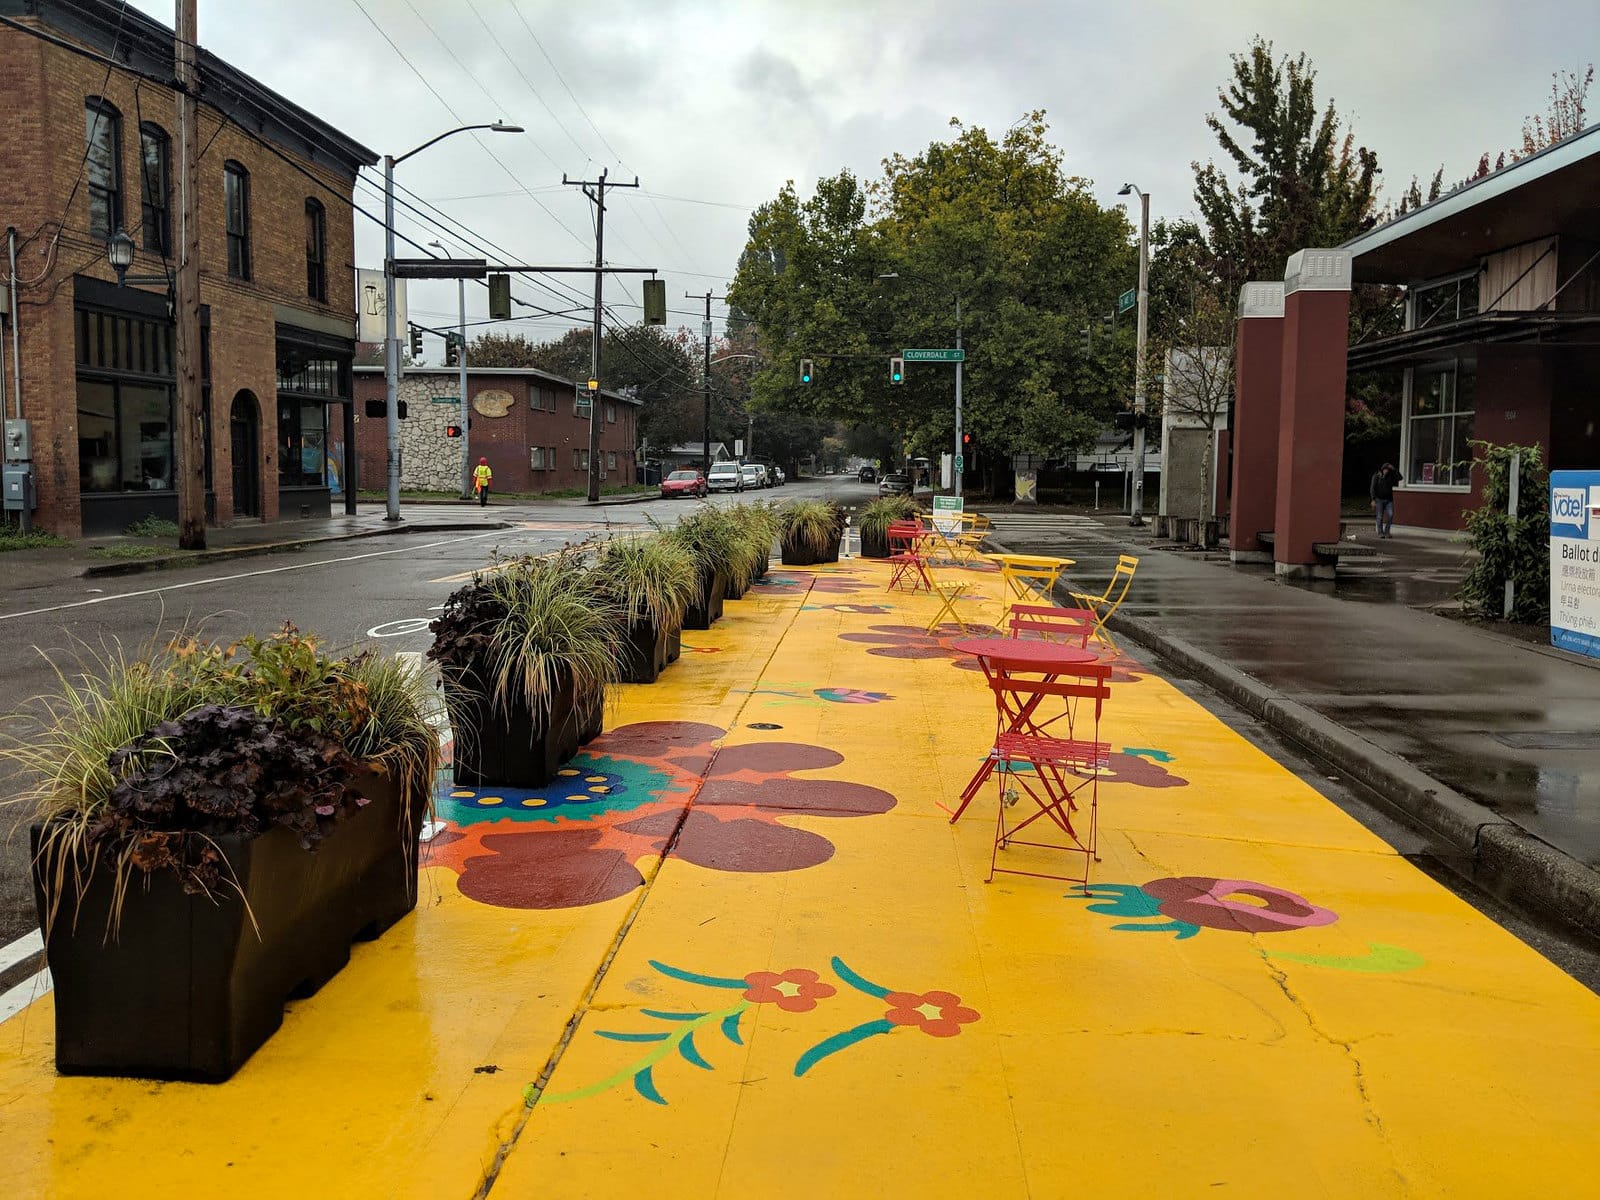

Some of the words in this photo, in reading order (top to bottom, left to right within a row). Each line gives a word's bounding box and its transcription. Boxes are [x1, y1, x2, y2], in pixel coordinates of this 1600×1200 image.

[907, 351, 948, 359] CLOVERDALE
[1562, 543, 1590, 562] Ballot
[1592, 546, 1600, 564] d
[1560, 581, 1576, 594] Urna
